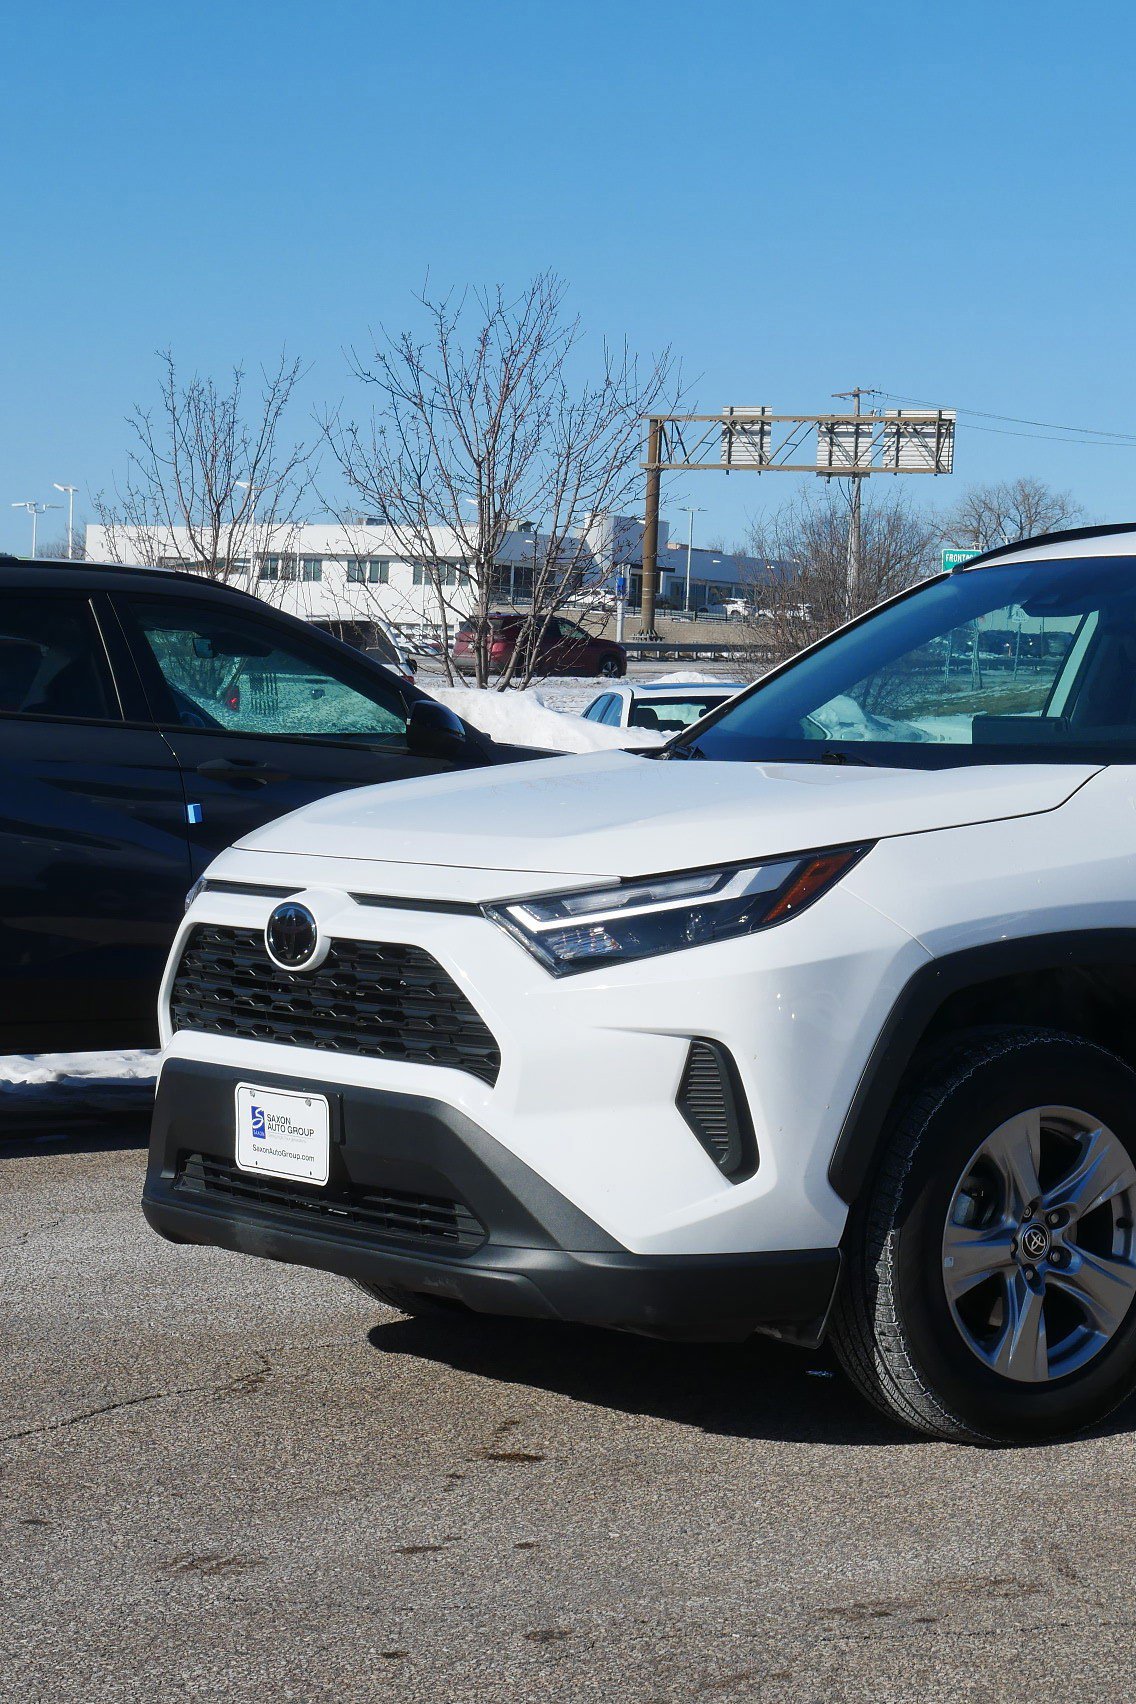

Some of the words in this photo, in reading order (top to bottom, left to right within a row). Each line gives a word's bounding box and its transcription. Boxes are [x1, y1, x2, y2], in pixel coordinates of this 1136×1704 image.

[266, 1113, 291, 1125] SAXON
[267, 1123, 286, 1133] AUTO
[287, 1125, 315, 1137] GROUP
